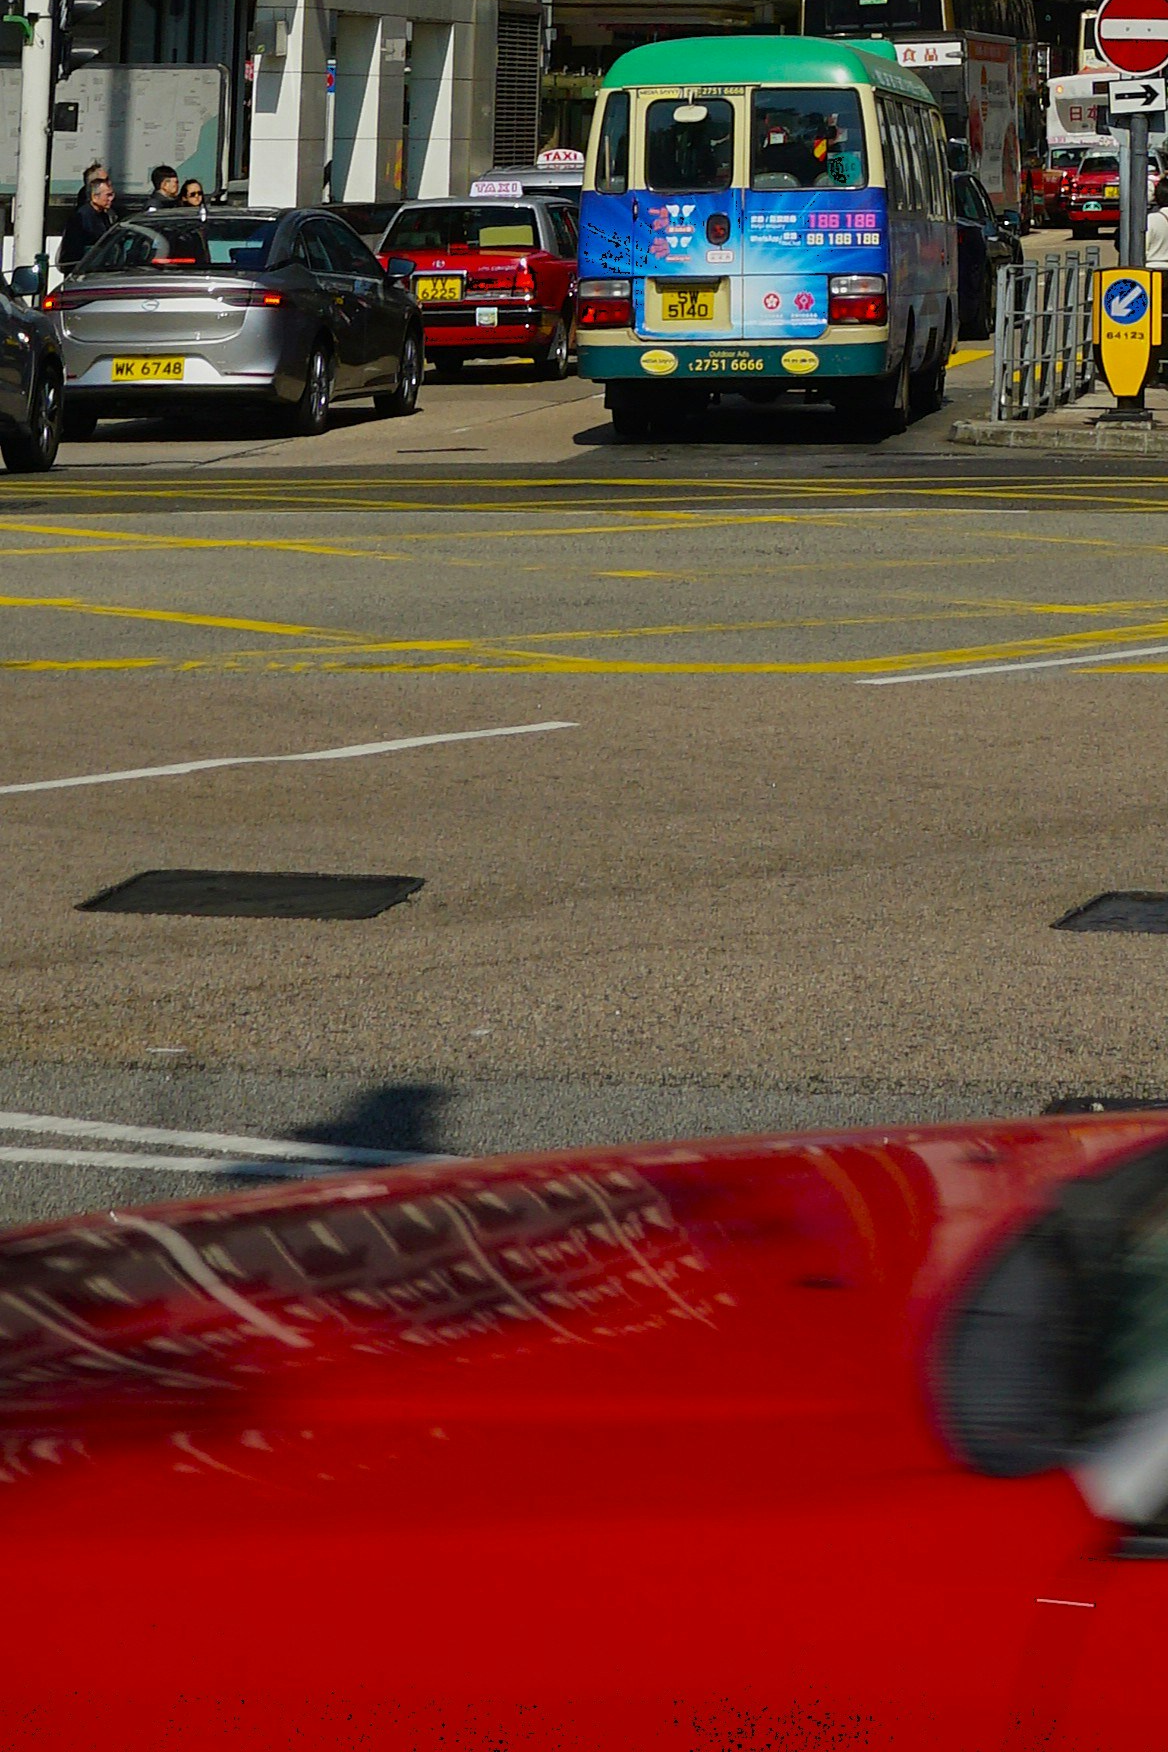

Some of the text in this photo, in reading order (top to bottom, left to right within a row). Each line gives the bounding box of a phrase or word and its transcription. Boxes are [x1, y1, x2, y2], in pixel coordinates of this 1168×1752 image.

[902, 47, 938, 62] 食品
[544, 150, 578, 162] TAXI
[475, 182, 518, 193] TAXI
[421, 288, 457, 299] 6225
[677, 291, 700, 304] SW
[668, 303, 709, 317] 5140
[1106, 331, 1145, 340] 64123
[709, 350, 750, 358] Outdoor Ads
[115, 361, 182, 375] WK 6748
[695, 358, 764, 371] 2751 6666
